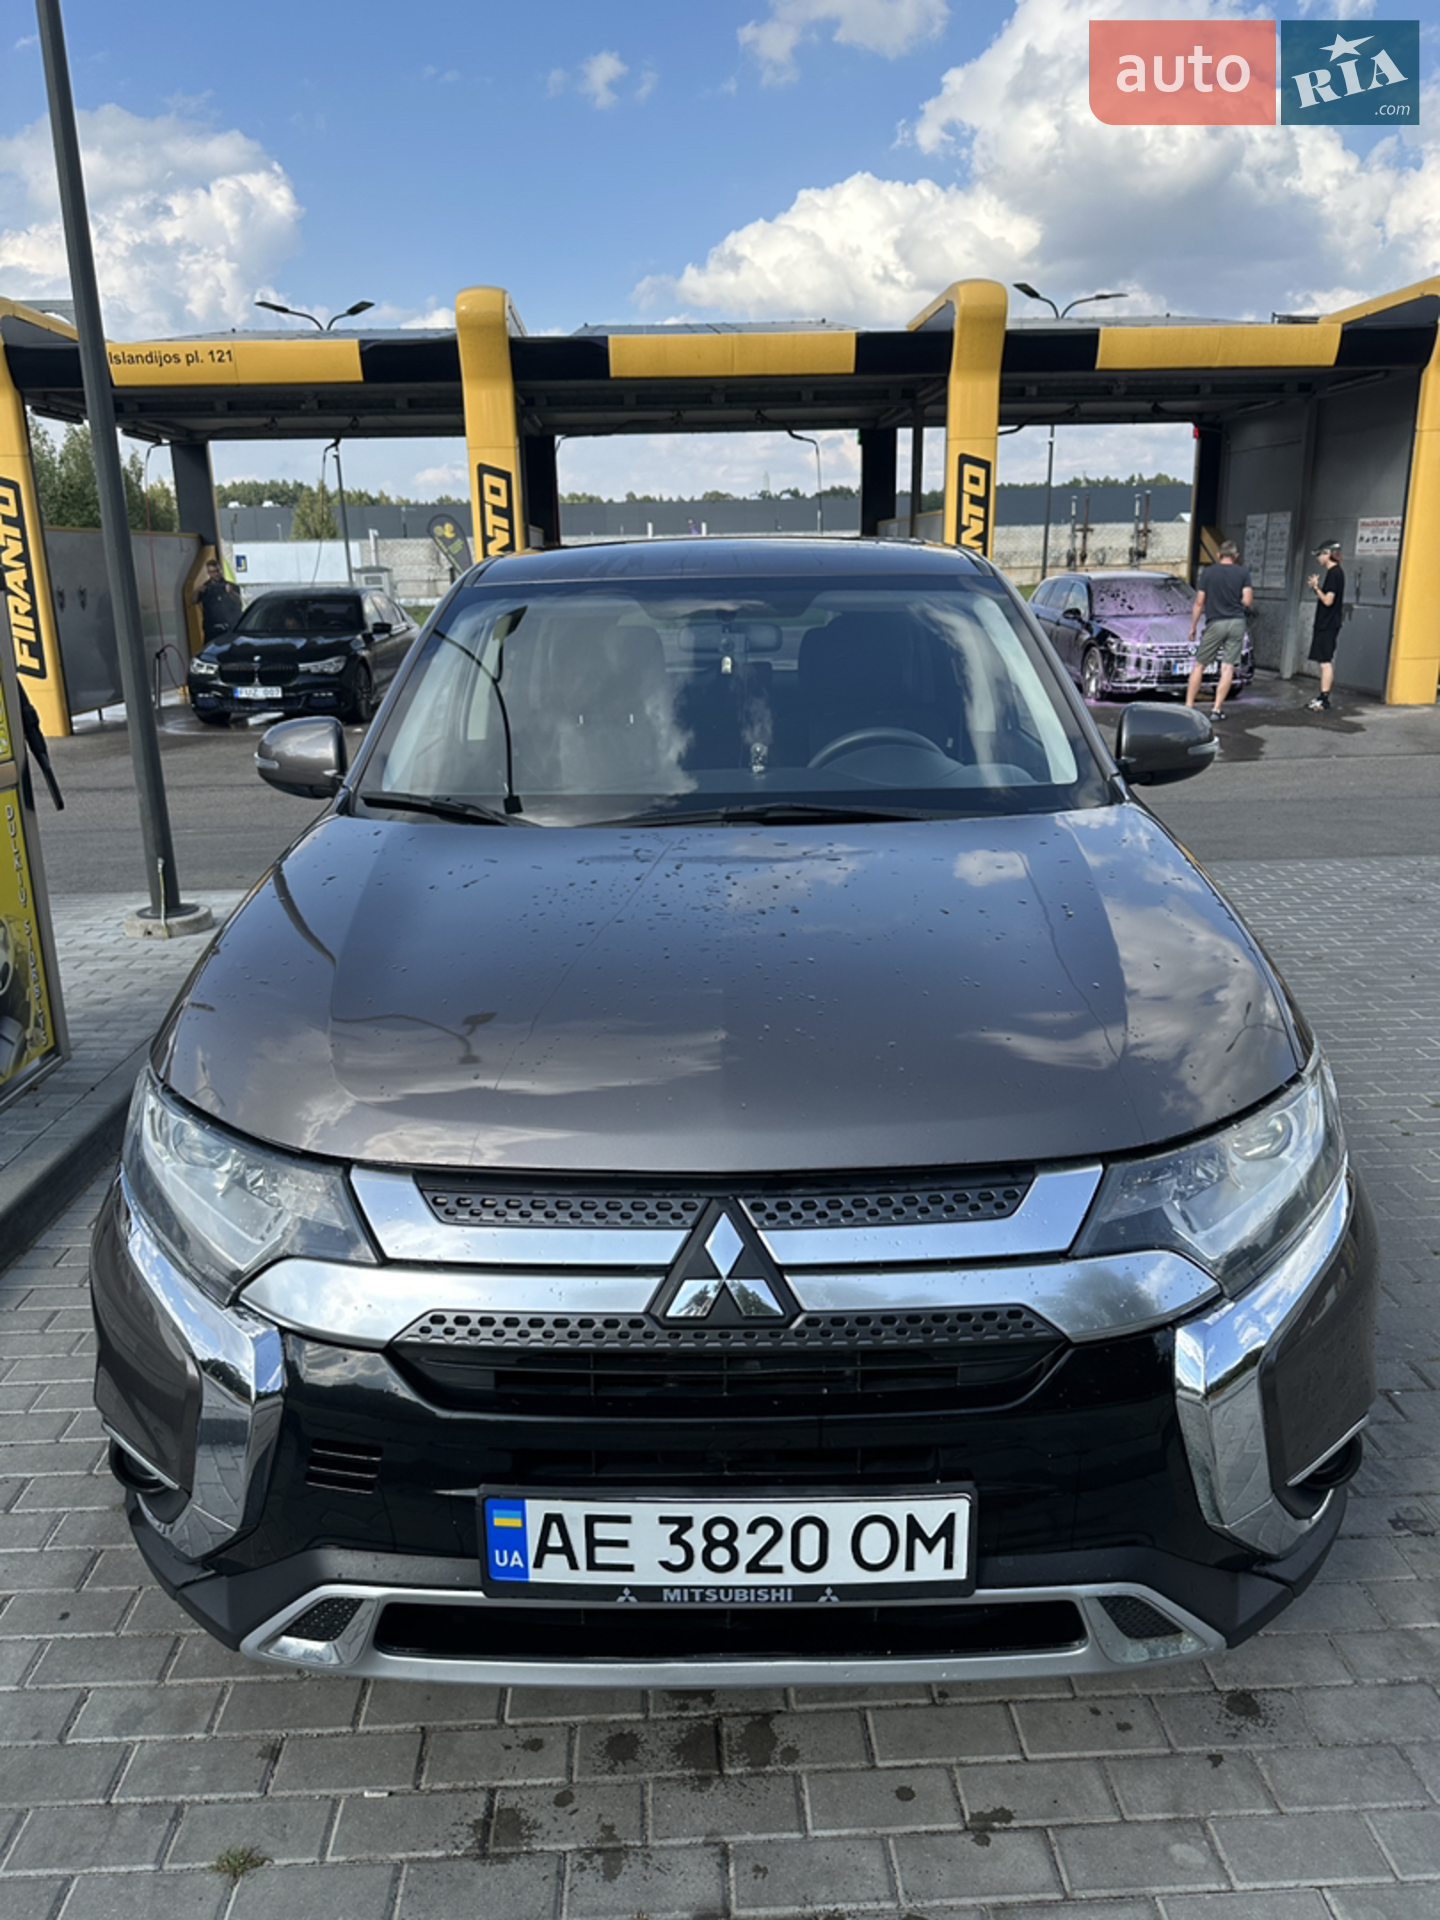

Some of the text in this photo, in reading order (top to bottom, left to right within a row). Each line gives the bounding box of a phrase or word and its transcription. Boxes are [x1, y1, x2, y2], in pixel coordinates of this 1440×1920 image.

[108, 349, 233, 367] Islandijos pl. 121
[532, 1511, 957, 1573] AE 3820 OM
[494, 1548, 523, 1569] UA
[662, 1587, 793, 1603] MITSUBISHI
